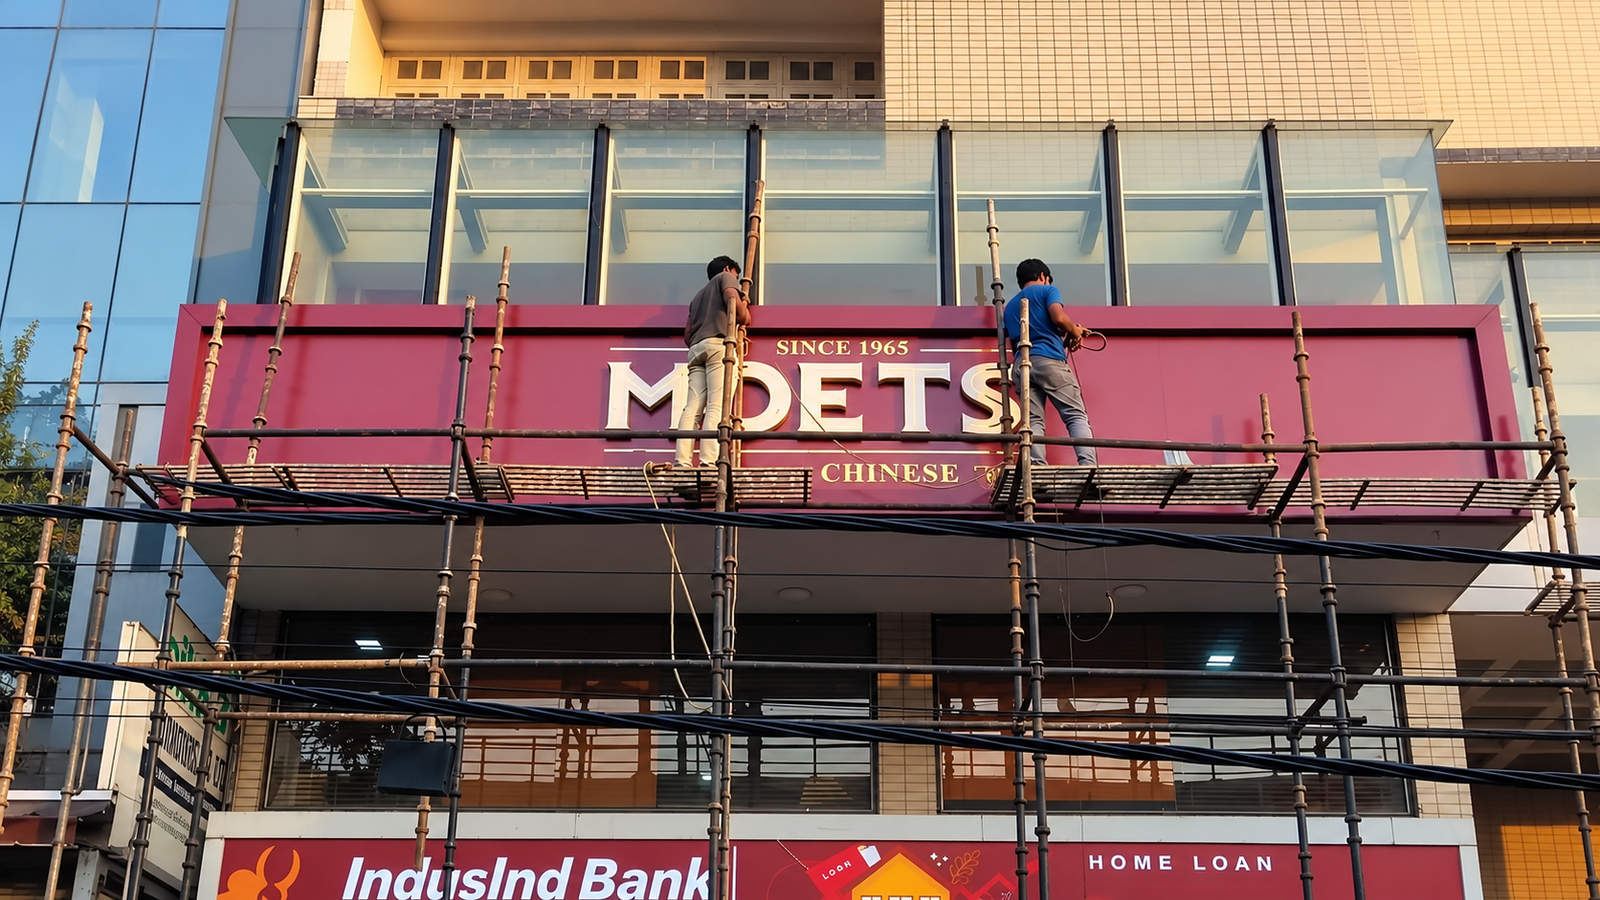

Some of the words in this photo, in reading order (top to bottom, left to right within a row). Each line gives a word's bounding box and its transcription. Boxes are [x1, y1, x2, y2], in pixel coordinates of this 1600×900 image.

[776, 340, 851, 356] SINCE
[859, 340, 909, 356] 1965
[604, 361, 1022, 437] MOETS
[821, 463, 959, 483] CHINESE
[1088, 855, 1172, 870] HOME
[1193, 855, 1272, 871] LOAN
[342, 856, 575, 900] IndusInd
[578, 856, 710, 900] Bank
